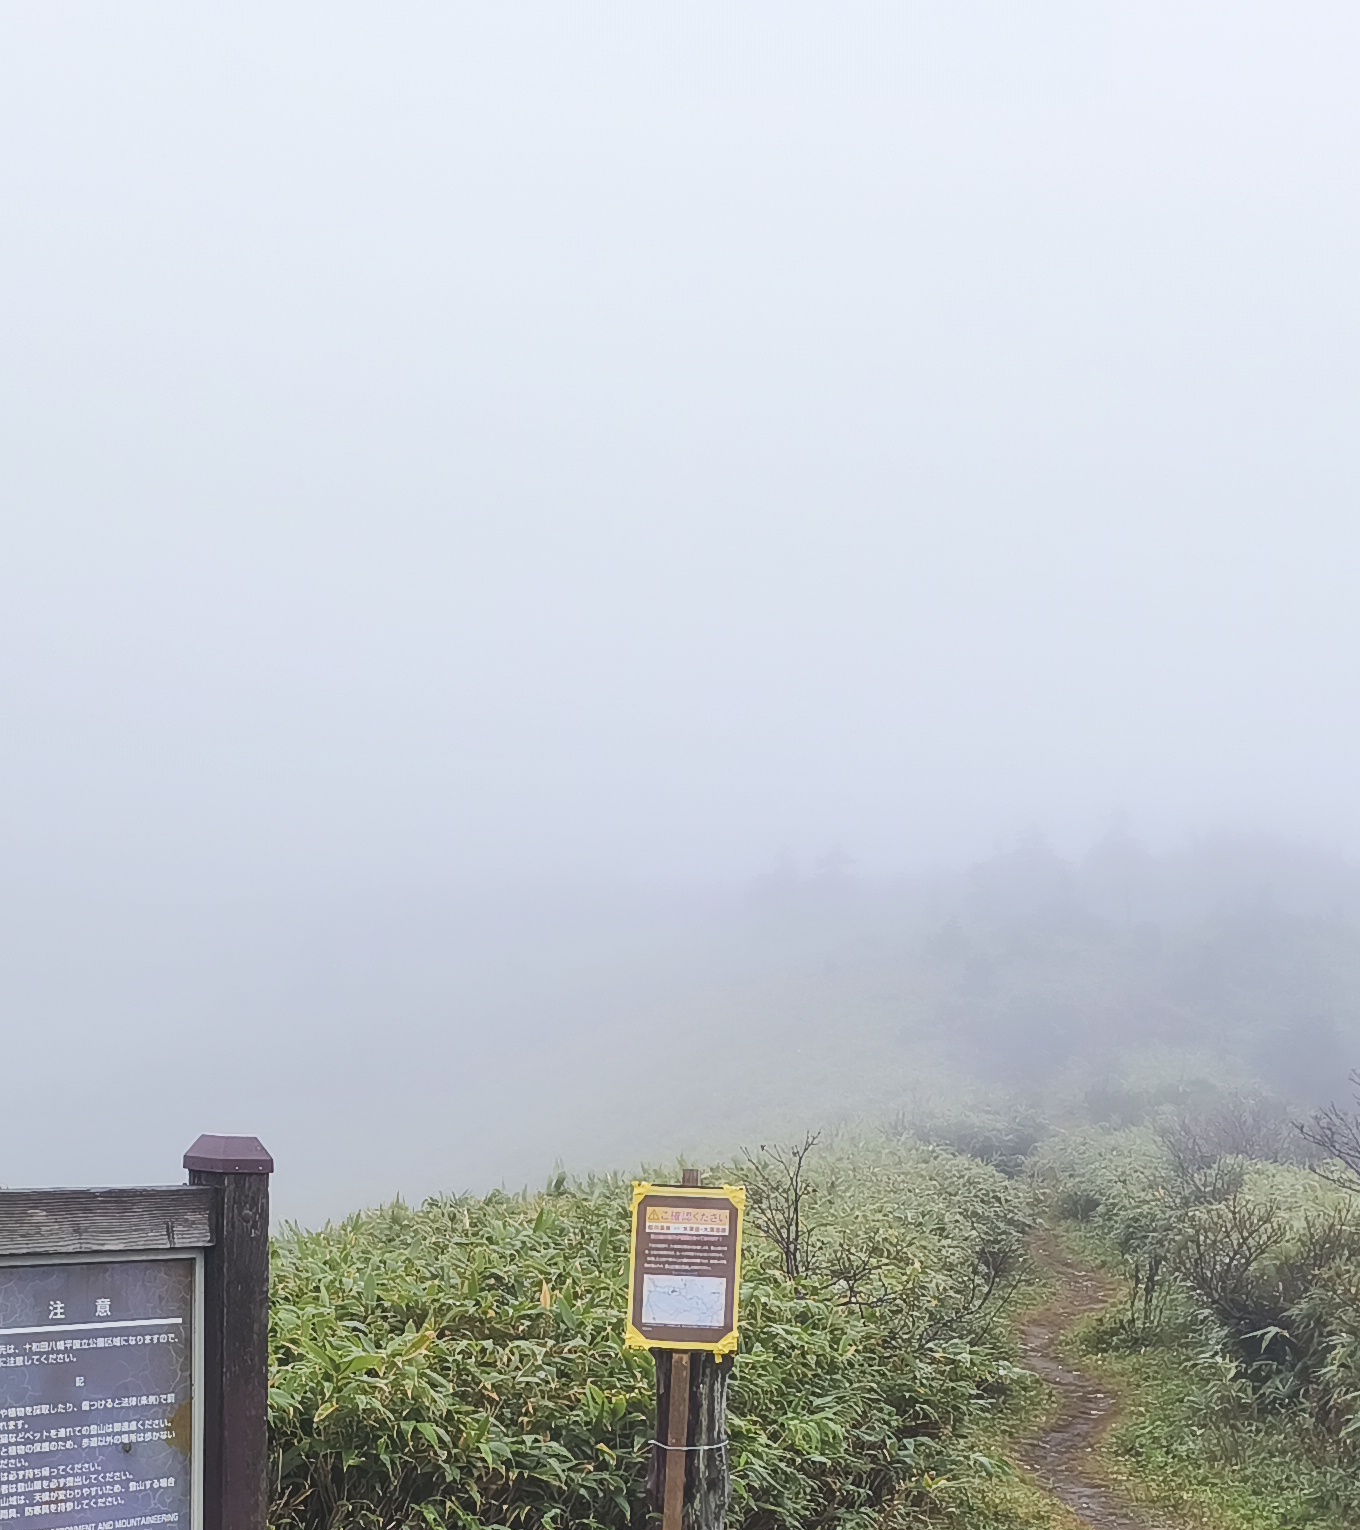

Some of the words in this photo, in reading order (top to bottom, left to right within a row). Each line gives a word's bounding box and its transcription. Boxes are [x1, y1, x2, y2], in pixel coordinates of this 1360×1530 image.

[49, 1298, 111, 1319] 注意
[75, 1376, 85, 1387] 記
[97, 1520, 114, 1530] AND
[115, 1512, 179, 1529] MOUNTAINEERING
